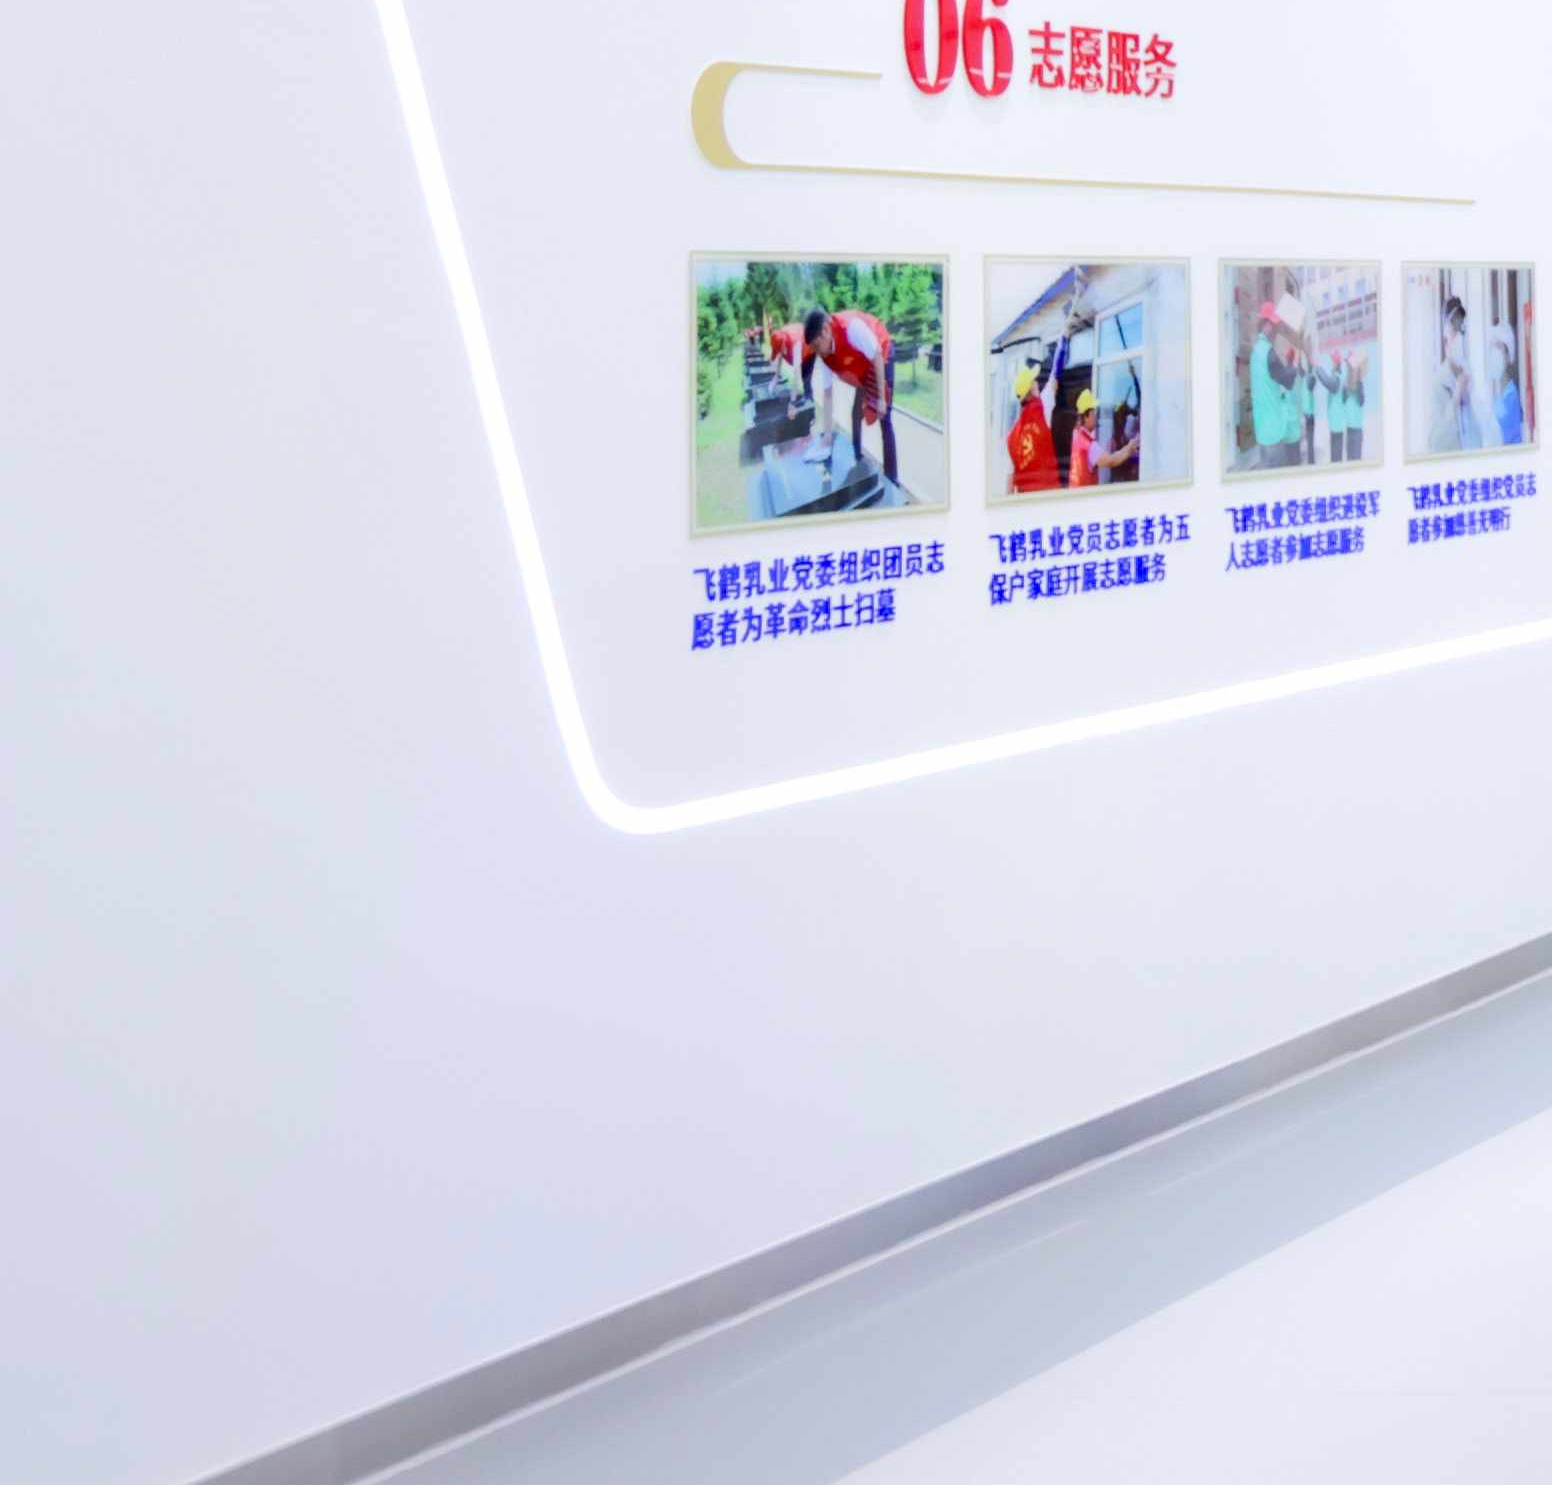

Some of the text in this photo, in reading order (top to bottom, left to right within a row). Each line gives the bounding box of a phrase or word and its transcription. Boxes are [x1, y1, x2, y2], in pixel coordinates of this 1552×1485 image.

[1029, 21, 1177, 100] 志愿服务
[989, 514, 1191, 564] 飞鹤乳业党员志愿者为五
[1226, 527, 1364, 572] 人志愿者参加志愿服务
[694, 541, 945, 602] 飞鹤乳业党委组织团员志
[989, 553, 1166, 606] 保户家庭开展志愿服务
[691, 589, 896, 651] 愿者为革命烈士扫墓
